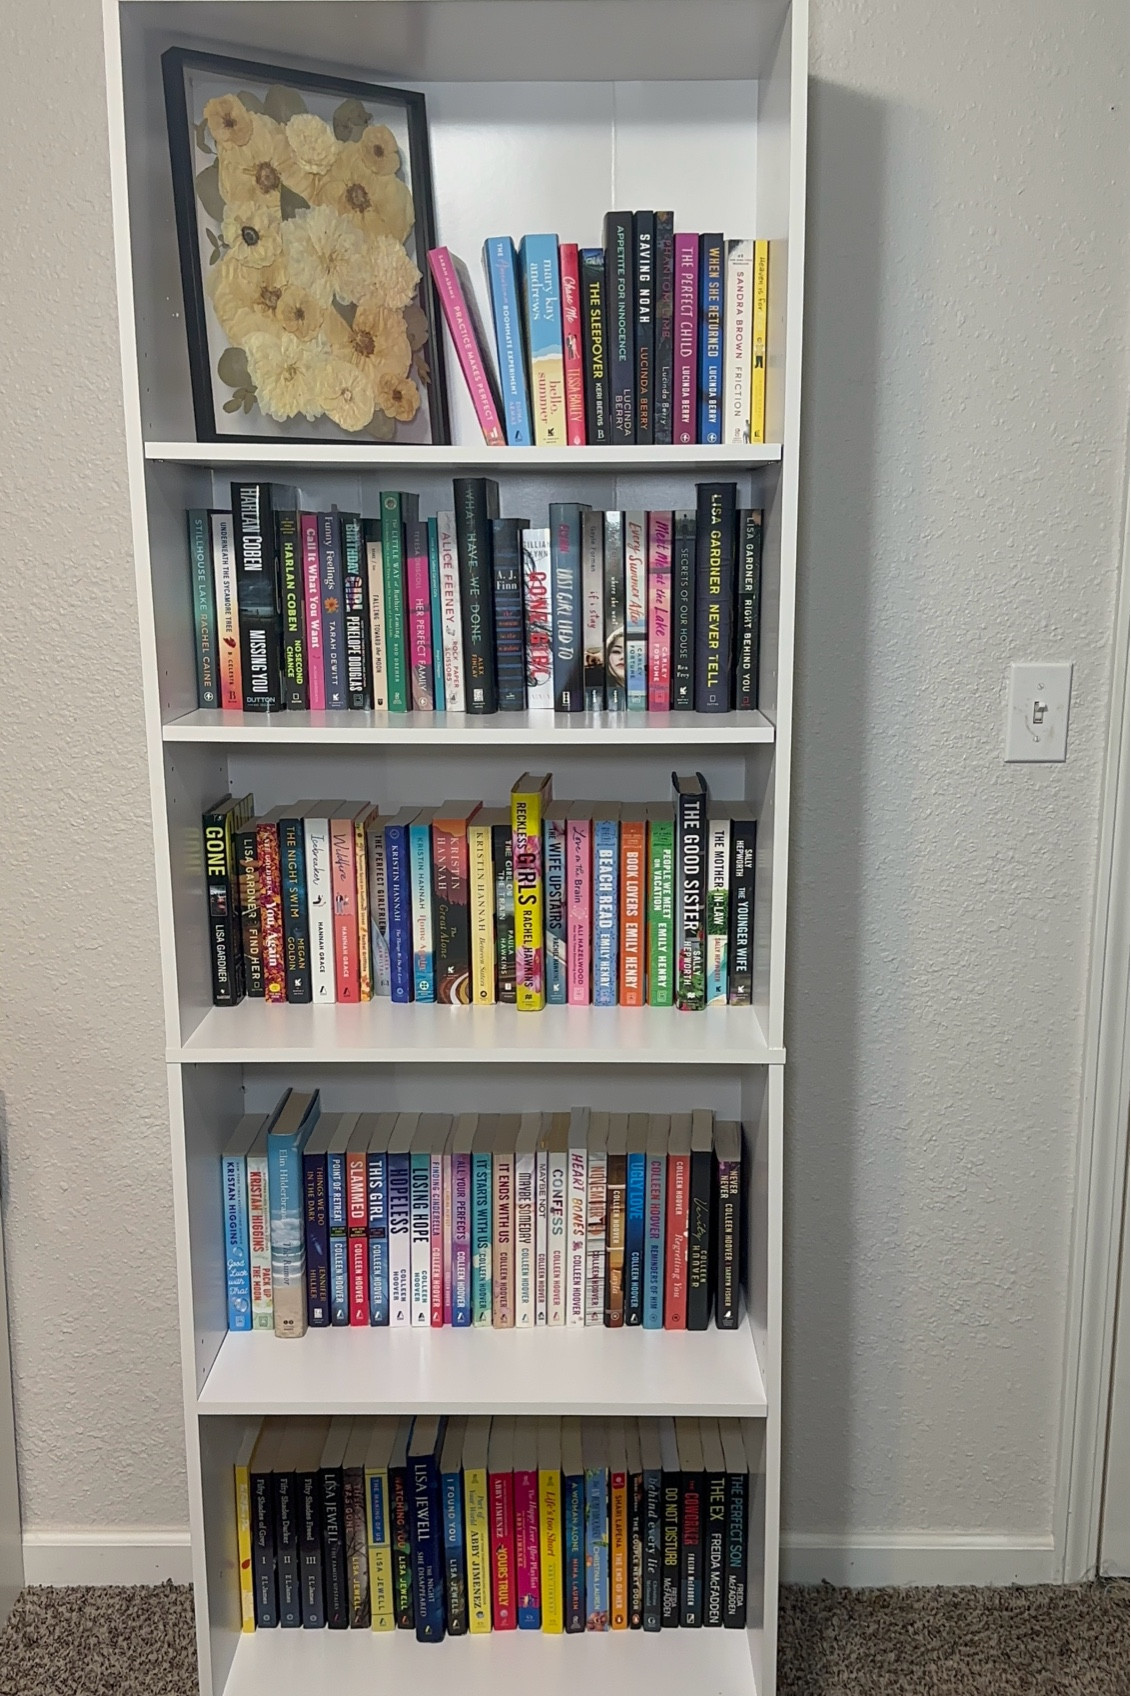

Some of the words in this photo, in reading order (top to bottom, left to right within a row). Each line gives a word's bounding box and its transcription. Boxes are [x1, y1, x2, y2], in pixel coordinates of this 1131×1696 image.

[617, 226, 625, 275] APPETITE
[640, 234, 649, 281] SAVING
[681, 247, 693, 267] THE
[709, 248, 719, 277] WHEN
[531, 263, 542, 319] andrews
[543, 260, 553, 294] mary
[708, 282, 718, 301] SHE
[590, 282, 600, 305] THE
[640, 289, 650, 323] NOAH
[681, 273, 693, 316] PERFECT
[736, 272, 744, 314] SANDRA
[544, 297, 556, 321] kay
[503, 305, 514, 348] ROOMMATE
[680, 322, 692, 357] CHILD
[708, 306, 718, 357] RETURNED
[591, 309, 602, 378] SLEEPOVER
[454, 306, 473, 349] PRACTICE
[466, 351, 481, 381] MAKES
[476, 383, 493, 421] PERFECT
[507, 351, 517, 395] EXPERIMENT
[595, 383, 603, 399] KERI
[734, 367, 742, 417] FRICTION
[195, 520, 205, 581] STILLHOUSE
[243, 535, 263, 570] COBEN
[306, 528, 316, 549] Call
[442, 532, 452, 569] ALICE
[284, 543, 295, 589] HARLAN
[308, 552, 317, 561] It
[309, 564, 319, 593] What
[557, 569, 572, 589] LAST
[199, 585, 207, 611] LAKE
[287, 593, 297, 631] COBEN
[310, 596, 320, 617] You
[415, 598, 424, 616] HER
[444, 574, 454, 623] FEENEY
[557, 593, 572, 615] GIRL
[201, 614, 210, 653] RACHEL
[310, 620, 320, 648] Want
[416, 620, 425, 657] PERFECT
[557, 620, 573, 642] LIED
[709, 605, 719, 648] NEVER
[249, 630, 266, 670] MISSING
[558, 647, 573, 659] TO
[743, 633, 751, 669] BEHIND
[203, 656, 211, 687] CAINE
[252, 673, 268, 692] YOU
[418, 660, 426, 691] FAMILY
[708, 655, 718, 687] TELL
[742, 673, 750, 692] YOU
[517, 802, 527, 849] RECKLESS
[684, 801, 699, 829] THE
[205, 827, 225, 876] GONE
[287, 826, 295, 847] THE
[288, 850, 297, 883] NIGHT
[311, 834, 324, 886] Icebreaker
[476, 832, 485, 880] KRISTIN
[549, 843, 560, 873] WIFE
[626, 851, 638, 877] BOOK
[683, 834, 699, 874] GOOD
[736, 840, 744, 877] HEPWORTH
[517, 853, 536, 905] GIRLS
[600, 850, 612, 890] BEACH
[290, 888, 299, 917] SWIM
[478, 884, 486, 931] HANNAH
[549, 876, 561, 928] UPSTAIRS
[600, 896, 612, 927] READ
[626, 881, 638, 916] LOVERS
[684, 880, 699, 930] SISTER
[215, 925, 225, 942] LISA
[523, 910, 532, 944] RACHEL
[625, 923, 637, 952] EMILY
[737, 901, 748, 945] YOUNGER
[601, 934, 610, 958] EMILY
[736, 948, 747, 971] WIFE
[216, 944, 227, 982] GARDNER
[524, 947, 533, 987] HAWKINS
[601, 961, 610, 987] HENRY
[625, 957, 637, 988] HENRY
[227, 1162, 237, 1200] KRISTAN
[332, 1159, 340, 1180] POINT
[369, 1161, 382, 1188] THIS
[457, 1160, 465, 1175] ALL
[499, 1164, 509, 1172] IT
[572, 1154, 584, 1192] HEART
[730, 1170, 738, 1194] NEVER
[250, 1171, 262, 1210] KRISTAN
[333, 1182, 341, 1190] OF
[350, 1162, 364, 1218] SLAMMED
[390, 1169, 408, 1234] HOPELESS
[413, 1168, 428, 1209] LOSING
[457, 1178, 465, 1198] YOUR
[499, 1176, 509, 1200] ENDS
[333, 1193, 341, 1222] RETREAT
[370, 1193, 382, 1221] GIRL
[499, 1203, 509, 1228] WITH
[552, 1169, 563, 1235] CONFESS
[573, 1198, 584, 1236] BONES
[725, 1203, 733, 1232] COLLEEN
[228, 1204, 238, 1245] HIGGINS
[252, 1215, 264, 1252] HIGGINS
[413, 1214, 429, 1243] HOPE
[457, 1200, 465, 1240] PERFECTS
[519, 1203, 531, 1244] SOMEDAY
[499, 1231, 509, 1243] US
[724, 1235, 733, 1261] HOOVER
[334, 1243, 343, 1273] COLLEEN
[457, 1251, 465, 1279] COLLEEN
[573, 1255, 581, 1285] COLLEEN
[672, 1234, 683, 1279] Regretting
[335, 1276, 344, 1302] HOOVER
[457, 1282, 465, 1307] HOOVER
[573, 1288, 581, 1315] HOOVER
[673, 1283, 682, 1298] You
[414, 1465, 427, 1492] LISA
[711, 1478, 724, 1501] THE
[731, 1476, 743, 1495] THE
[647, 1478, 658, 1517] behind
[665, 1504, 677, 1522] NOT
[710, 1506, 723, 1520] EX
[416, 1496, 429, 1542] JEWELL
[730, 1498, 742, 1542] PERFECT
[646, 1522, 657, 1553] every
[665, 1527, 677, 1565] DISTURB
[711, 1533, 721, 1568] FREIDA
[497, 1549, 508, 1577] YOURS
[648, 1559, 657, 1573] lie
[730, 1545, 741, 1567] SON
[472, 1561, 481, 1609] JIMENEZ
[499, 1580, 509, 1605] TRULY
[710, 1572, 720, 1623] McFADDEN
